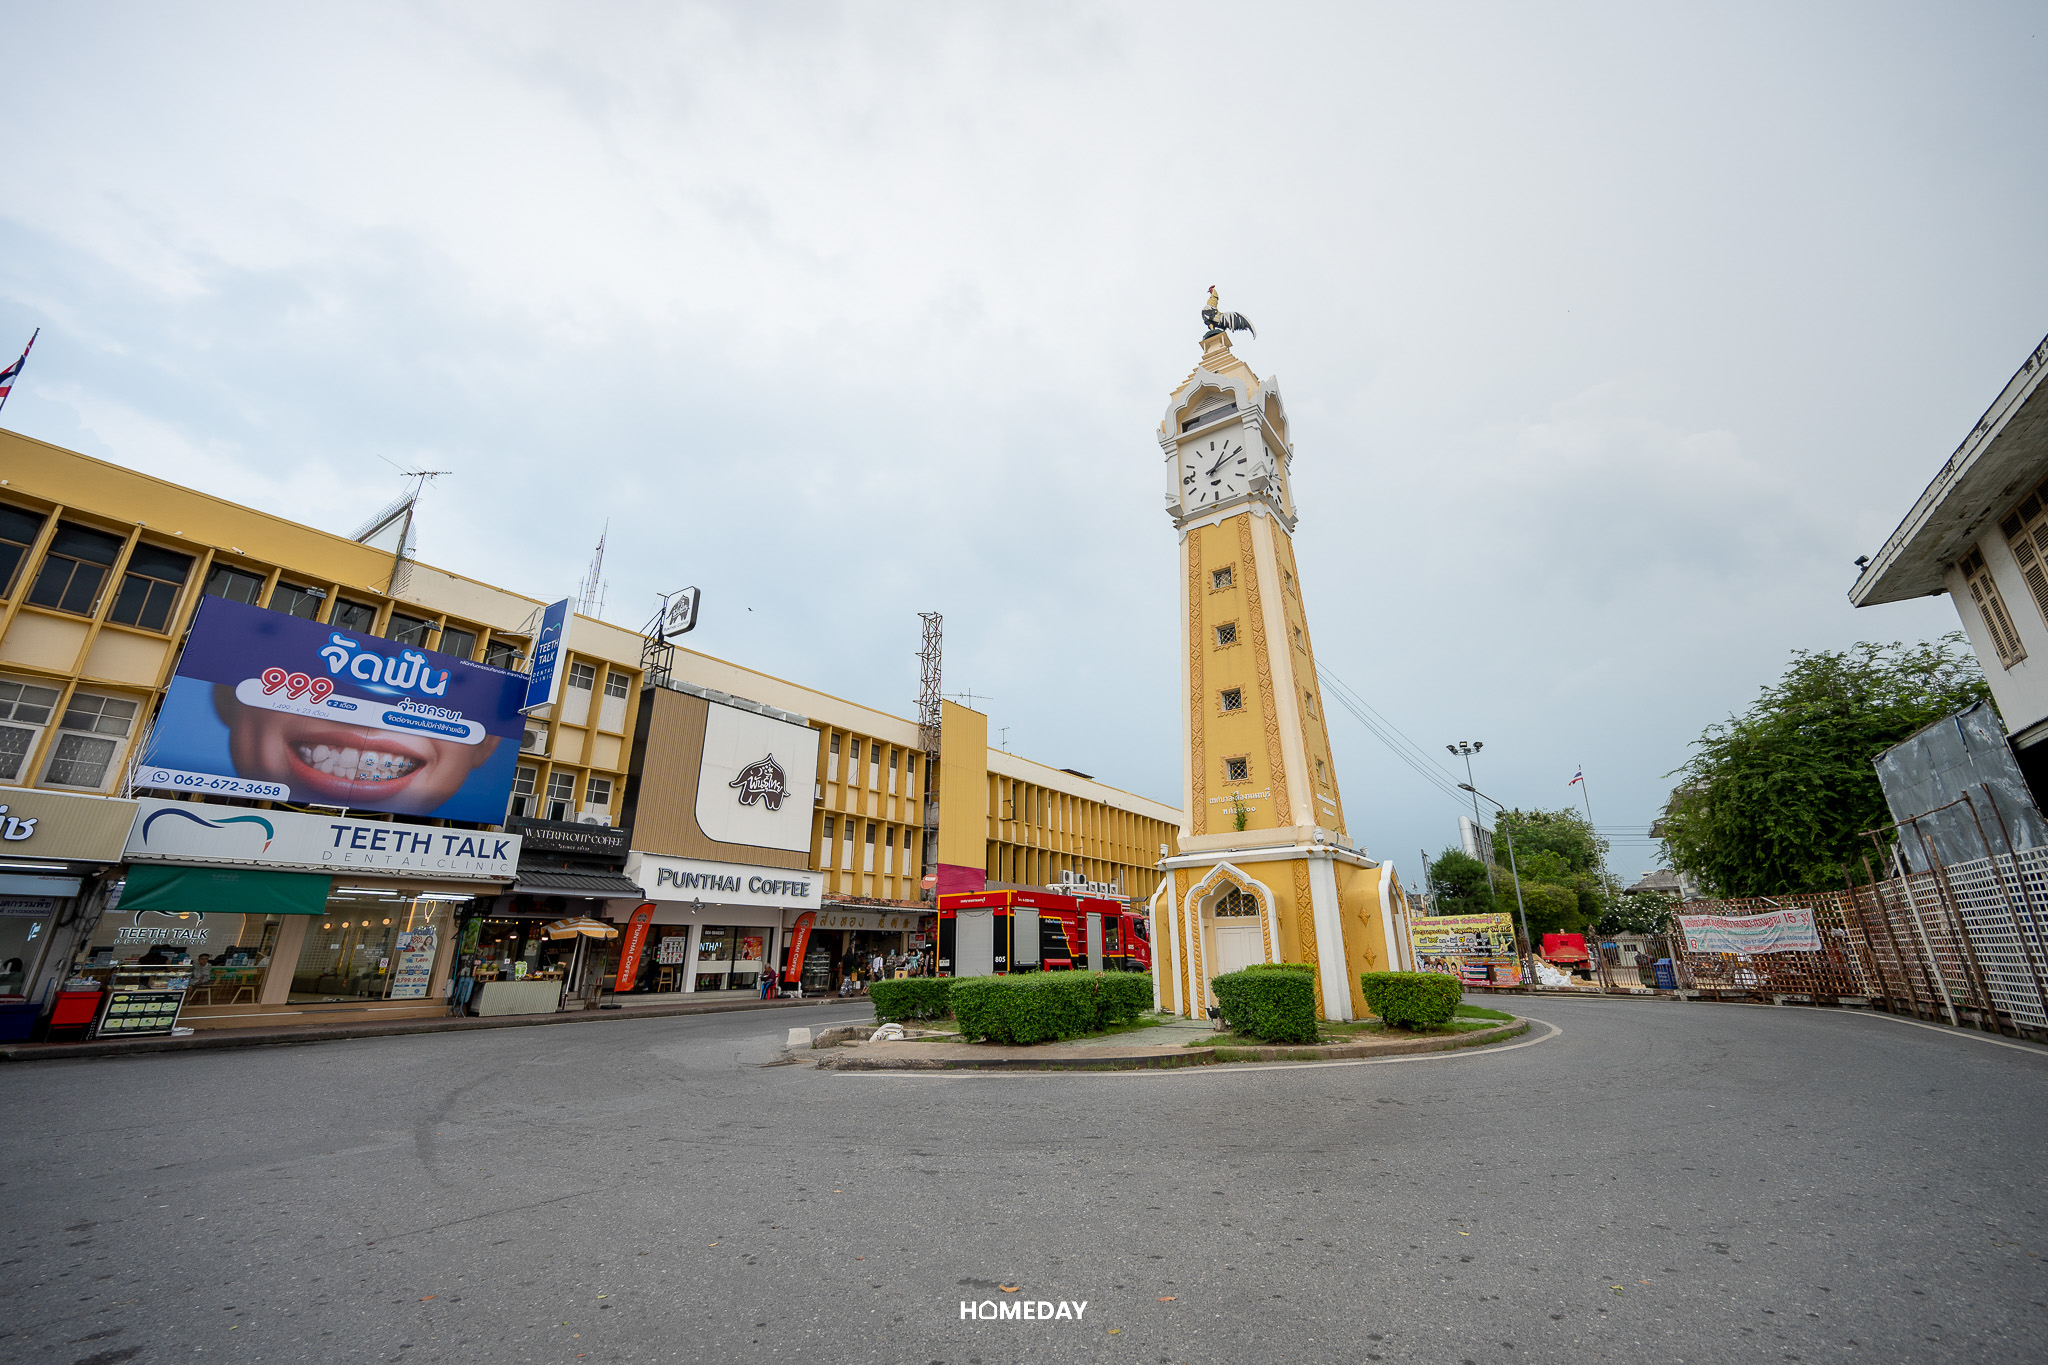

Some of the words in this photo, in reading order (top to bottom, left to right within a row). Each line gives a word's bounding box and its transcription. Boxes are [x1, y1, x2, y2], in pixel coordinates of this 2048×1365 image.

[539, 638, 559, 653] TEETH
[320, 633, 449, 697] จัดฟัน
[539, 651, 555, 664] TALK
[261, 667, 334, 704] 999
[340, 702, 356, 710] เดือน
[398, 697, 462, 722] จ่ายครบ!
[174, 774, 281, 796] 062-672-3658
[330, 824, 433, 854] TEETH
[442, 835, 511, 860] TALK
[591, 834, 624, 847] COFFEE
[322, 851, 427, 867] DENTAL
[437, 859, 508, 872] CLINIC
[657, 867, 741, 892] PUNTHAI
[748, 876, 811, 897] COFFEE
[1782, 912, 1796, 924] 15
[119, 927, 169, 938] TEETH
[172, 928, 209, 939] TALK
[629, 924, 642, 954] PUNTHAI
[795, 928, 805, 956] PUNTHAI
[621, 955, 633, 983] COFFEE
[790, 956, 799, 975] COFFEE
